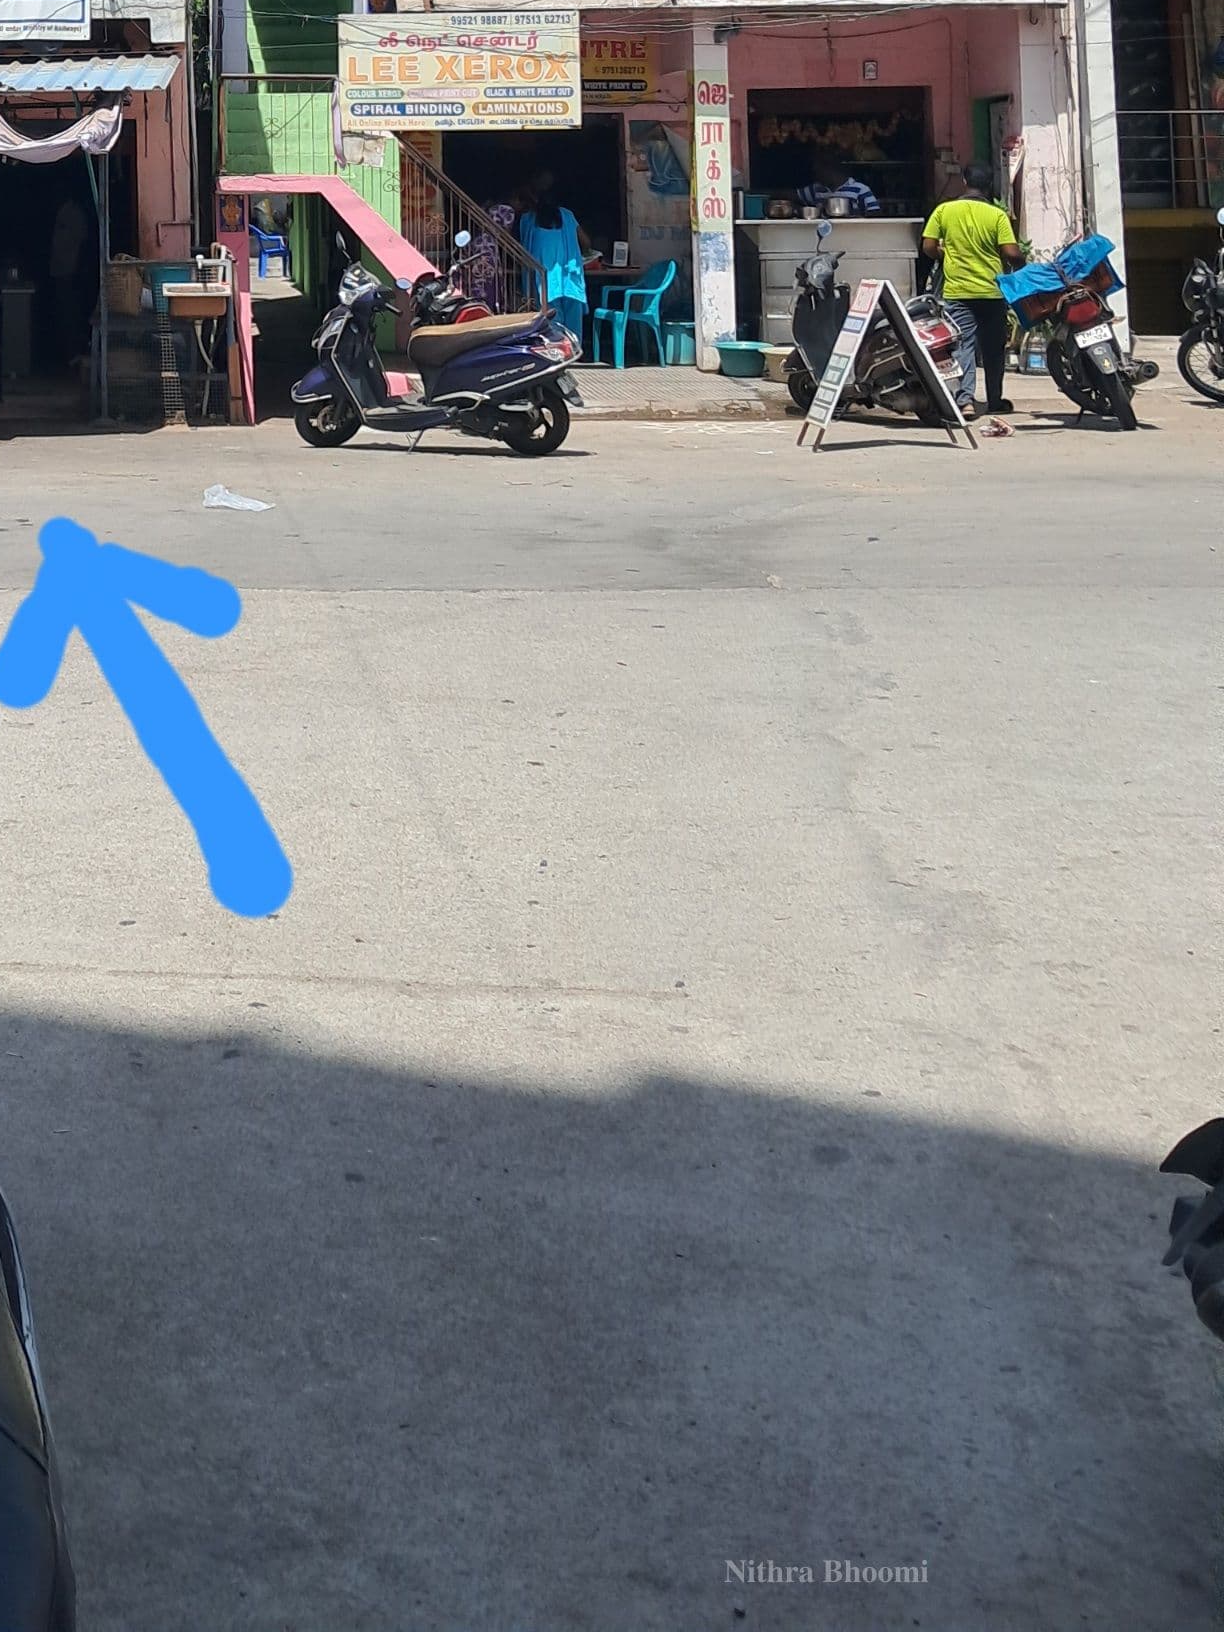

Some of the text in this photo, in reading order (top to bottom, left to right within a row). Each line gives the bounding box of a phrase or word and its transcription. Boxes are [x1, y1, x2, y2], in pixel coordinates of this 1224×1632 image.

[451, 16, 478, 26] 99521
[514, 14, 542, 25] 97513
[347, 52, 571, 84] LEE XEROX
[485, 88, 508, 97] BLACK
[557, 87, 571, 96] OUT
[353, 103, 463, 115] SPIRAL BINDING
[478, 102, 564, 114] LAMINATIONS
